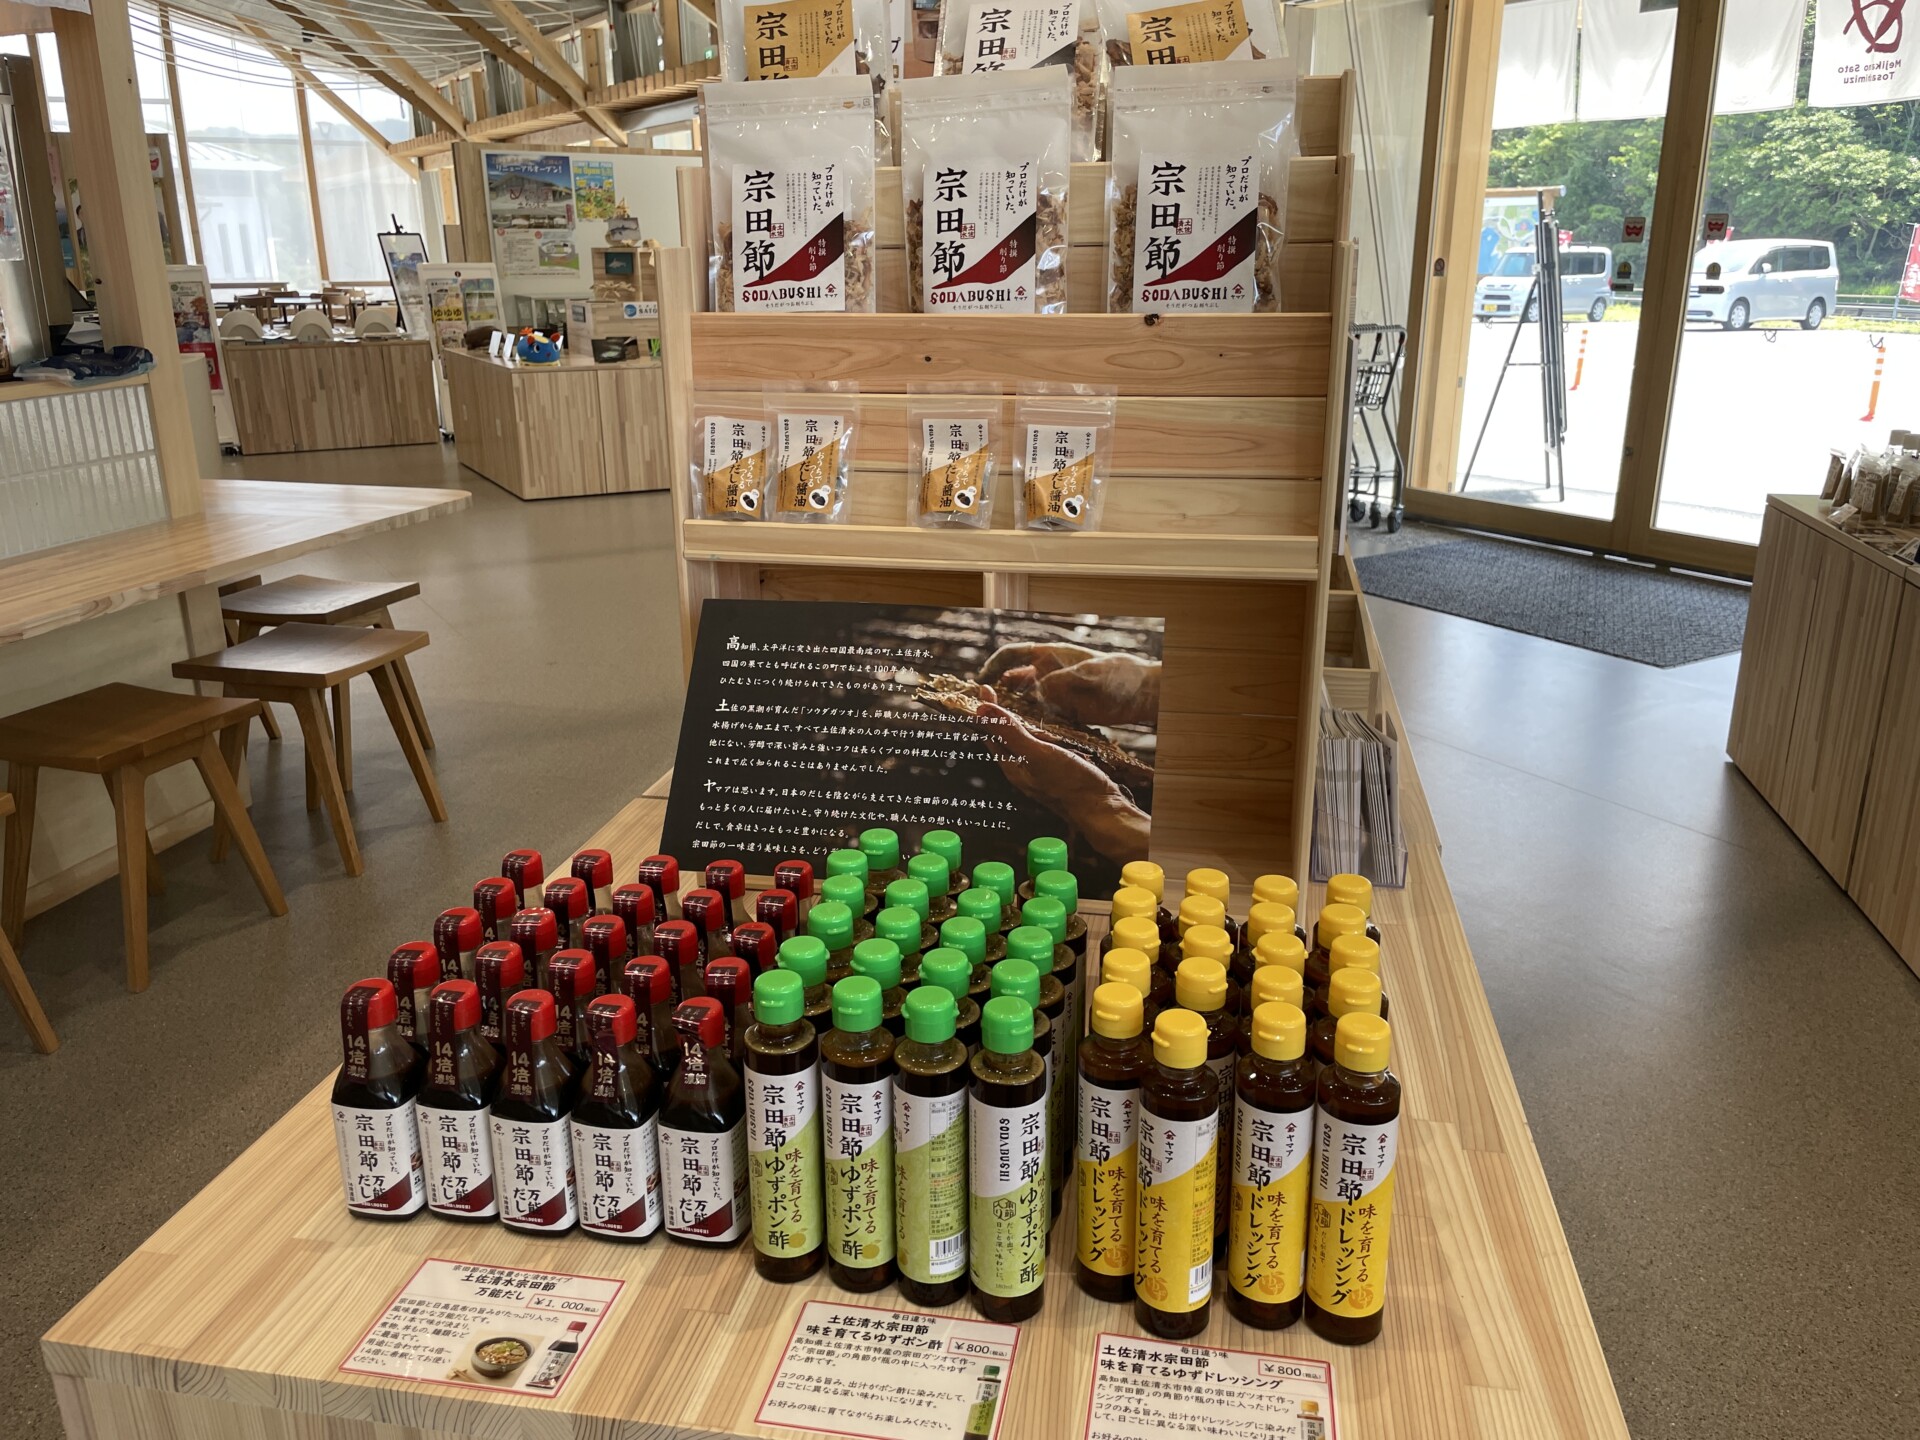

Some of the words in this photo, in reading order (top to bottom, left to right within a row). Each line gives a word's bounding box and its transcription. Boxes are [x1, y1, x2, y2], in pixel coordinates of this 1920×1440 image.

[823, 9, 835, 46] 知っていた。
[1047, 8, 1059, 42] 知っていた。
[1060, 3, 1072, 36] プロだけが
[1211, 10, 1229, 43] 知っていた。
[1225, 1, 1238, 36] プロだけが
[812, 172, 823, 214] 知っていた。
[825, 164, 834, 207] プロだけが
[1005, 170, 1016, 214] 知っていた。
[1019, 162, 1029, 207] プロだけが
[1225, 164, 1237, 210] 知っていた。
[1239, 156, 1252, 202] プロだけが
[740, 170, 776, 280] 宗田節
[930, 167, 968, 282] 宗田節
[1143, 161, 1187, 278] 宗田節
[808, 246, 816, 272] 削り節
[999, 248, 1007, 274] 削り節
[1216, 243, 1225, 271] 削り節
[720, 677, 907, 693] ひたむきにつくり続けられてきたものがあります。
[707, 757, 888, 774] これまで広く知られることはありませんでした。
[695, 821, 848, 838] だしで、食卓はきっともっと豊かになる。
[796, 1093, 805, 1114] ヤマア
[873, 1102, 882, 1124] ヤマア
[1123, 1110, 1132, 1133] ヤマア
[355, 1114, 378, 1173] 宗田節
[385, 1114, 400, 1175] プロだけが知っていた。
[439, 1114, 461, 1173] 宗田節
[468, 1115, 483, 1176] プロだけが知っていた。
[511, 1127, 534, 1187] 宗田節
[541, 1127, 556, 1190] プロだけが知っていた。
[1165, 1141, 1174, 1163] ヤマア
[1286, 1134, 1294, 1157] ヤマア
[1377, 1145, 1386, 1168] ヤマア
[592, 1133, 615, 1193] 宗田節
[621, 1134, 636, 1198] プロだけが知っていた。
[680, 1137, 702, 1197] 宗田節
[710, 1137, 723, 1201] プロだけが知っていた。
[763, 1084, 790, 1250] 宗田節ゆずポン酢
[839, 1093, 863, 1260] 宗田節ゆずポン酢
[1089, 1096, 1111, 1262] 宗田節ドレッシング
[357, 1174, 371, 1200] だし
[372, 1175, 386, 1199] 万能
[440, 1174, 454, 1200] だし
[455, 1176, 468, 1200] 万能
[513, 1186, 527, 1213] だし
[527, 1189, 541, 1214] 万能
[785, 1148, 804, 1223] 味を育てる
[861, 1158, 880, 1234] 味を育てる
[1019, 1112, 1040, 1284] 宗田節ゆずポン酢
[592, 1193, 606, 1220] だし
[607, 1195, 621, 1221] 万能
[679, 1198, 693, 1224] だし
[694, 1200, 708, 1224] 万能
[1108, 1166, 1127, 1242] 味を育てる
[1243, 1119, 1275, 1288] 宗田節ドレッシング
[1331, 1133, 1367, 1305] 宗田節ドレッシング
[1150, 1196, 1168, 1274] 味を育てる
[1266, 1191, 1287, 1269] 味を育てる
[1356, 1204, 1377, 1283] 味を育てる
[460, 1273, 557, 1291] 土佐清水宗田節
[475, 1287, 525, 1301] 万能だし
[827, 1314, 930, 1335] 土佐清水宗田節
[891, 1313, 937, 1325] 毎日違う味
[805, 1324, 944, 1351] 味を育てるゆずポン酢
[1180, 1347, 1229, 1359] 毎日違う味
[352, 1356, 386, 1367] ください。
[787, 1355, 837, 1367] ポン酢です。
[1102, 1344, 1209, 1368] 土佐清水宗田節
[1100, 1358, 1283, 1390] 味を育てるゆずドレッシング
[776, 1381, 938, 1409] 日ごとに異なる深い味わいになります。
[1096, 1392, 1148, 1407] シングです。
[768, 1399, 952, 1430] お好みの味に育てながらお楽しみください。
